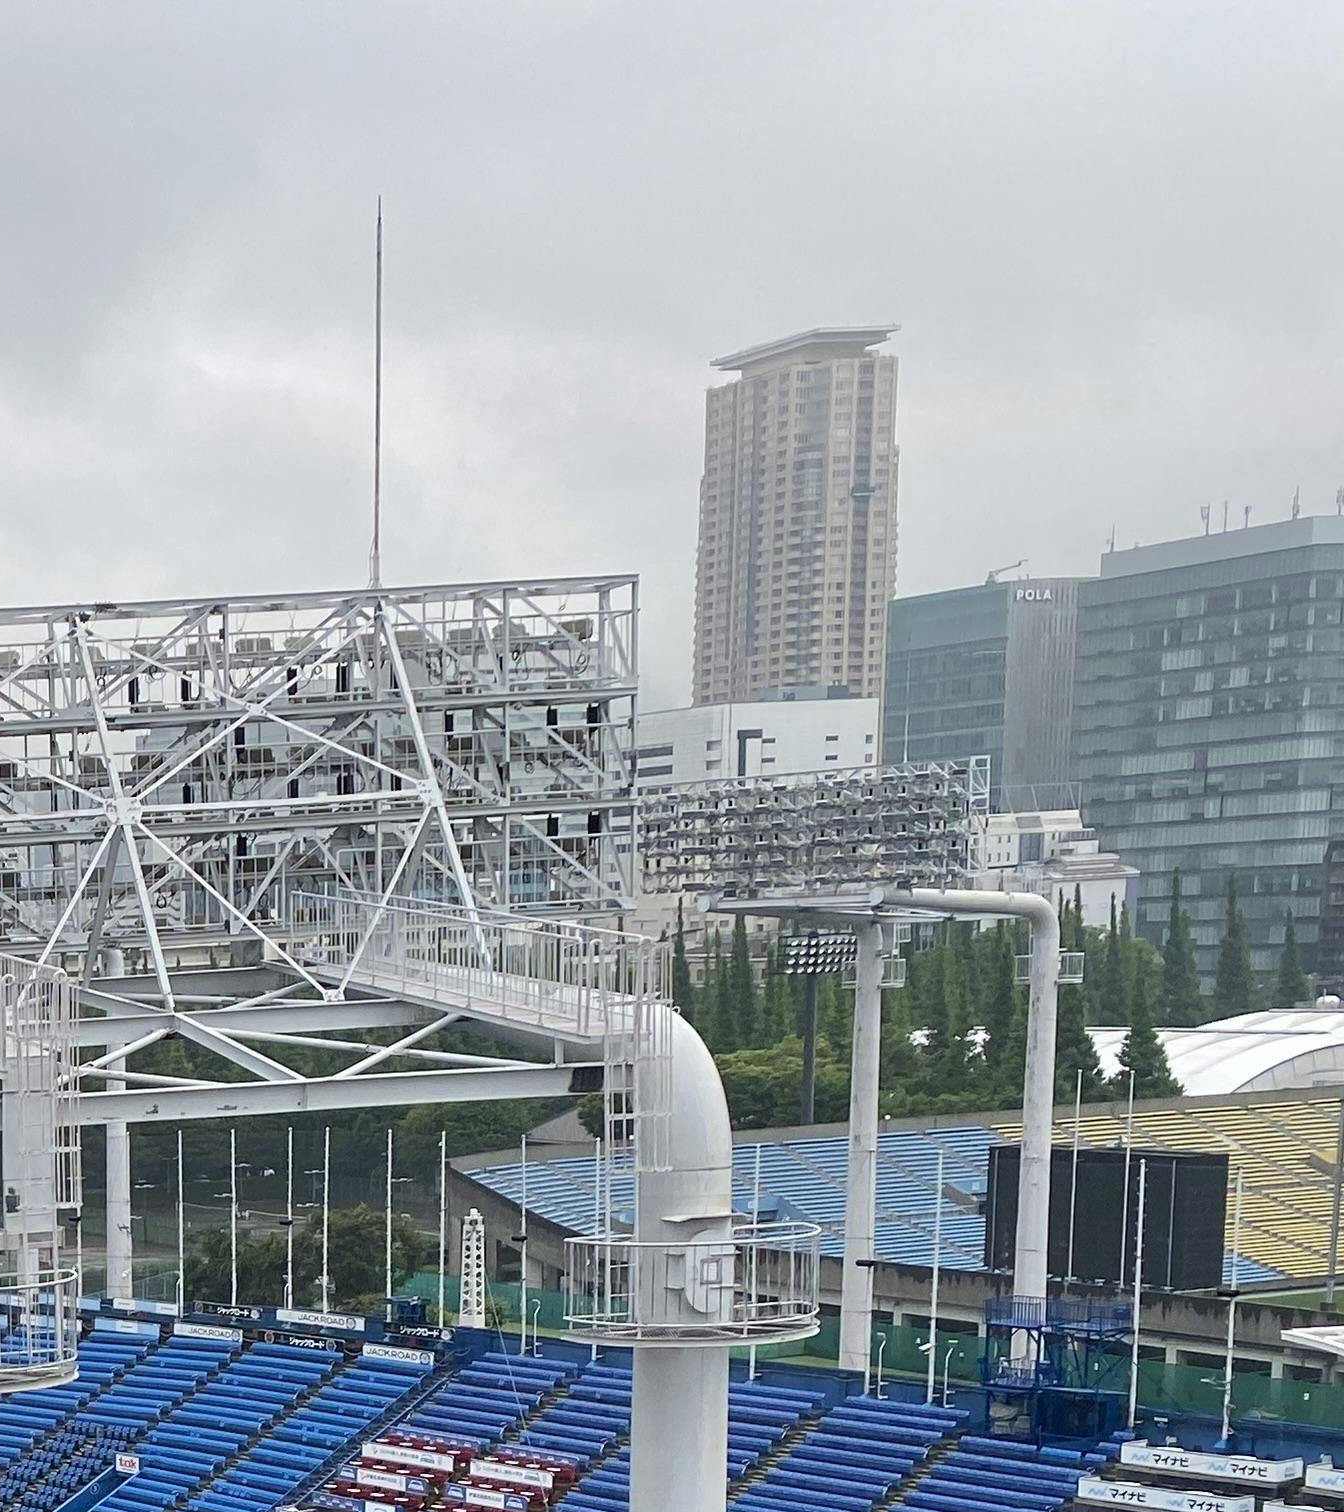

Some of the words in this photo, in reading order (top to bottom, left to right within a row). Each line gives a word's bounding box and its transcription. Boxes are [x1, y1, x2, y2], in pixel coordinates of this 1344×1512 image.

[1016, 589, 1052, 601] POLA
[297, 1313, 346, 1326] JACKROAD
[188, 1327, 232, 1339] JACKROAD
[366, 1346, 418, 1361] JACKROAD
[1153, 1453, 1190, 1468] マイナビ
[1230, 1462, 1269, 1478] マイナビ
[1109, 1487, 1147, 1503] マイナビ
